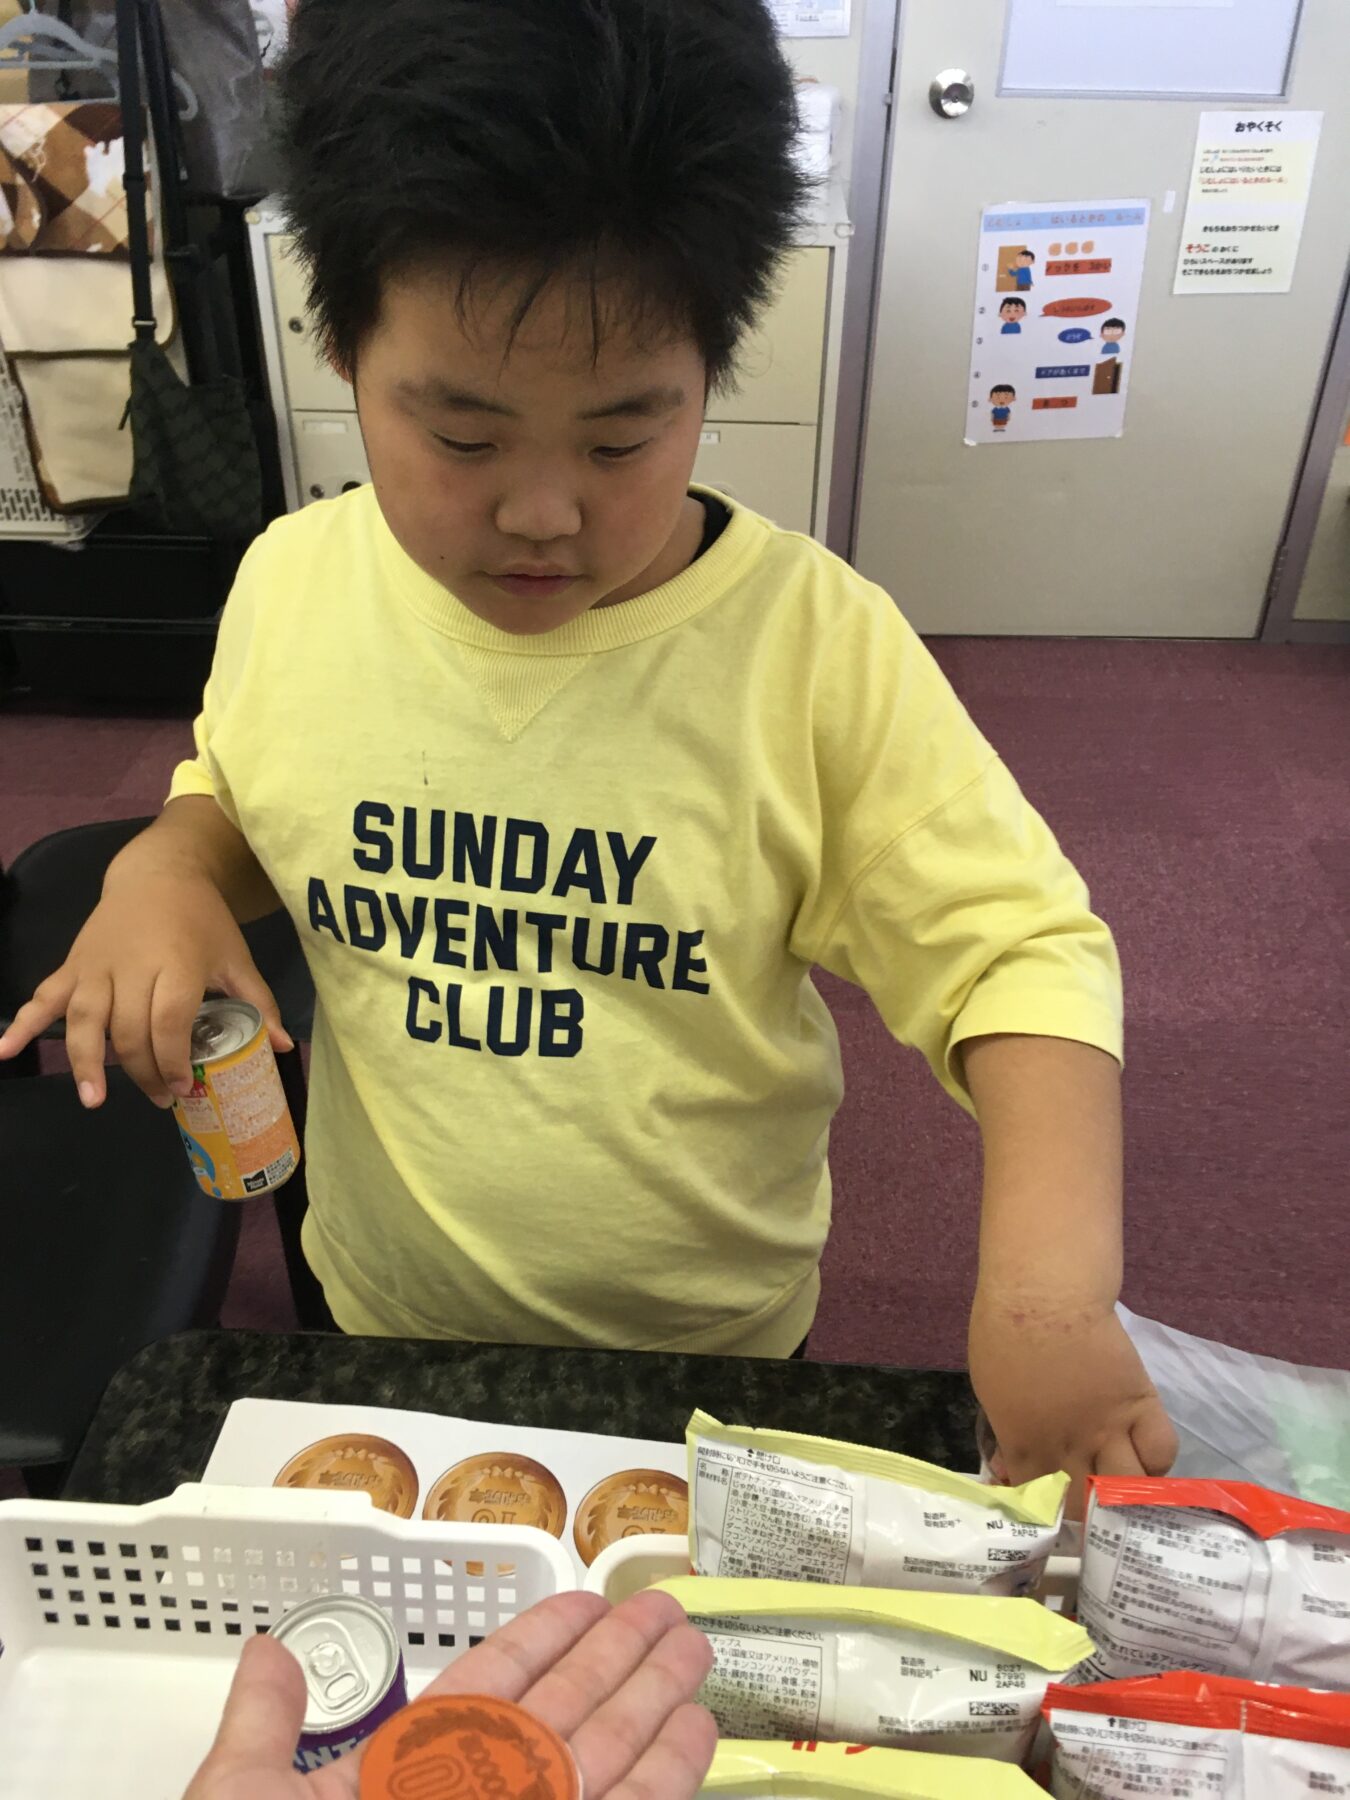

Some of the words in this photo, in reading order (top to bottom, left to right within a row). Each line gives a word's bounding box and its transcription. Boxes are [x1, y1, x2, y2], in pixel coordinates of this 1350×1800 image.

[1235, 121, 1283, 132] おやくそく
[353, 800, 657, 905] SUNDAY
[307, 876, 711, 995] ADVENTURE
[406, 976, 585, 1058] CLUB
[986, 1519, 1004, 1531] NU
[970, 1669, 988, 1682] NU
